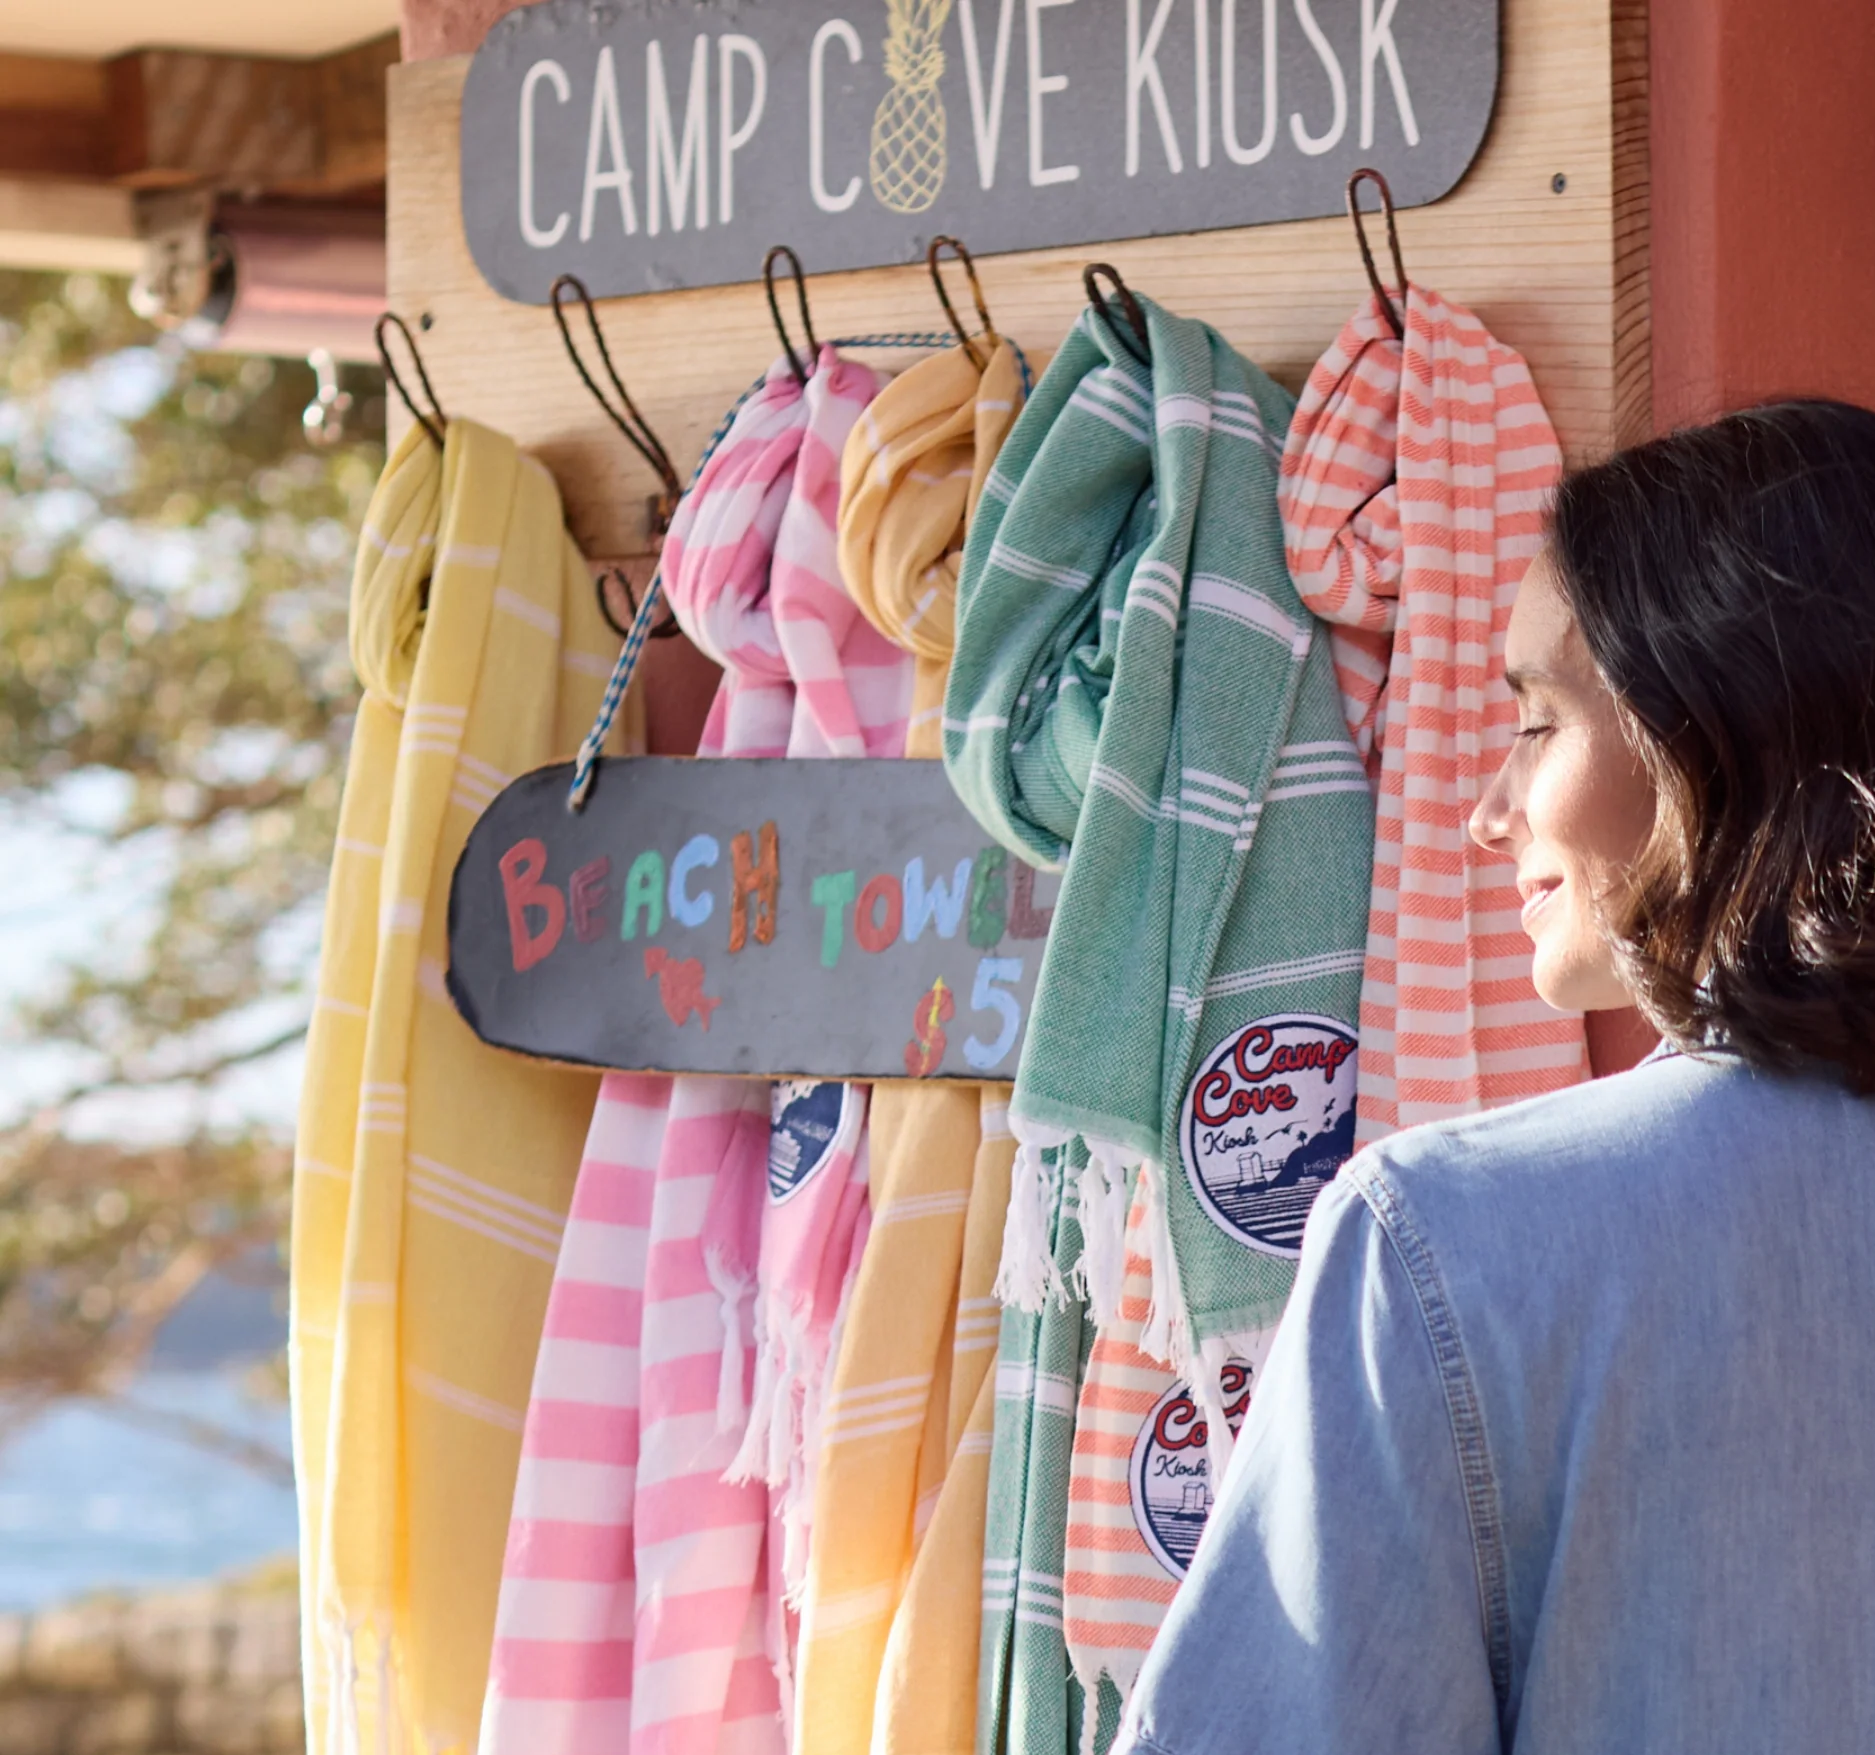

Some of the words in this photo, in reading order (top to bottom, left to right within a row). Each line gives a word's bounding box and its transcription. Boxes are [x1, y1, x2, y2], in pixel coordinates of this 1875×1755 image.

[519, 34, 767, 249] CAMP
[809, 0, 1080, 213] CVE
[1123, 0, 1419, 177] KIOSK
[499, 820, 781, 972] BEACH
[904, 957, 1023, 1077] $5
[1234, 1025, 1358, 1084] Camp
[1194, 1069, 1298, 1127] Cove
[1203, 1126, 1258, 1155] Kiosk
[1154, 1397, 1208, 1451] Co
[1153, 1454, 1207, 1478] Kiosk
